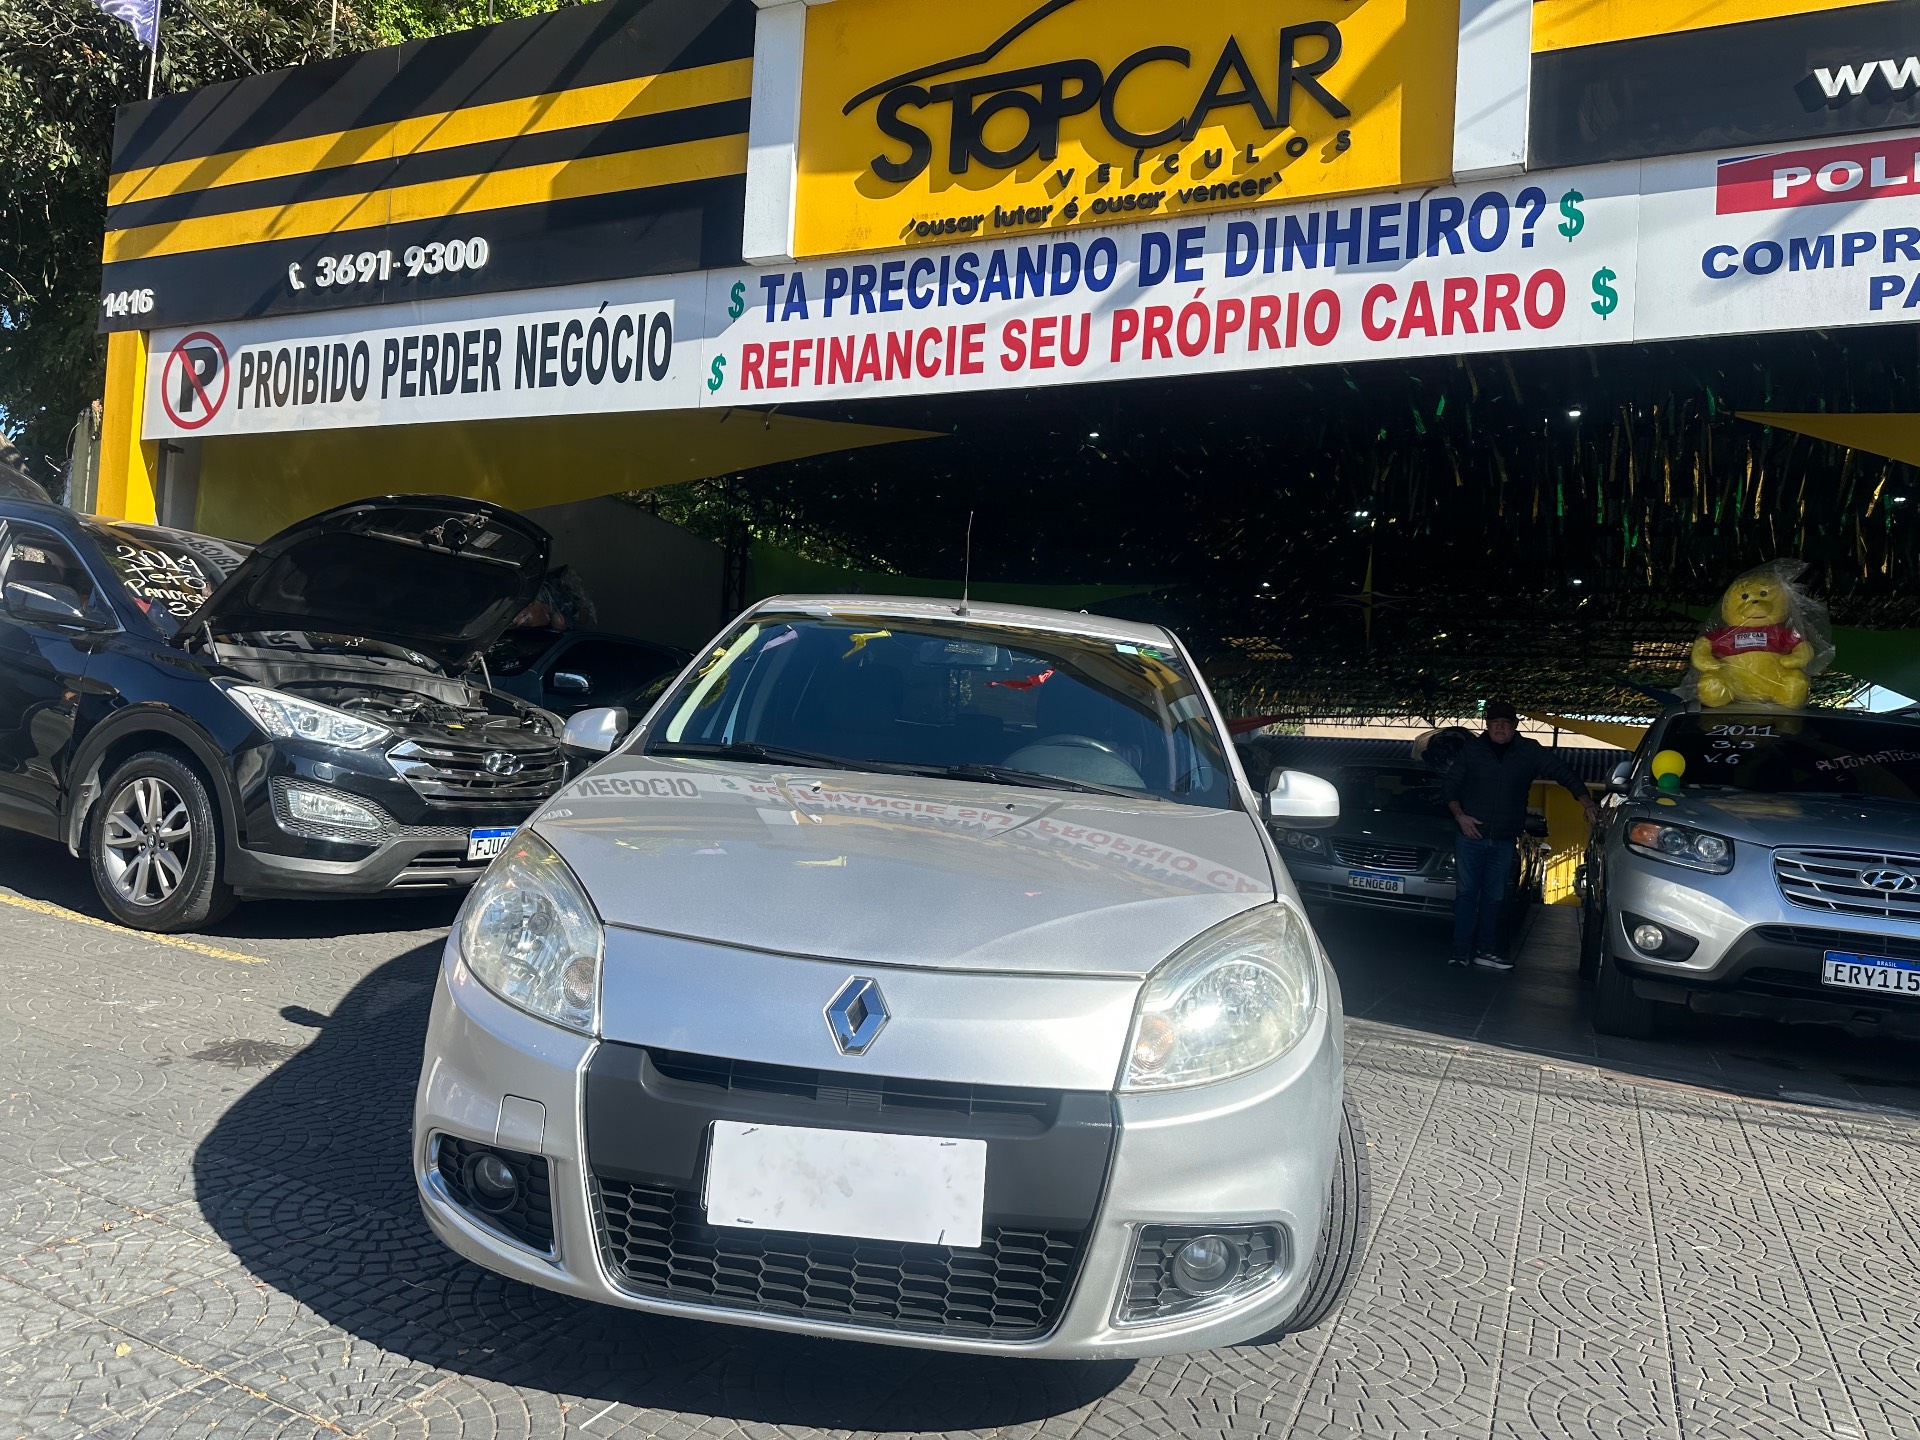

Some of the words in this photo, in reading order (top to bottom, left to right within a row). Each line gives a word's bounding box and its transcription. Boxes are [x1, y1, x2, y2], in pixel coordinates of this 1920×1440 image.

[1056, 130, 1351, 188] VEÍCULOS
[994, 203, 1053, 228] lutar
[1063, 196, 1079, 219] é
[1091, 189, 1166, 214] ousar
[315, 236, 490, 287] 3691-9300
[760, 272, 809, 323] TA
[823, 237, 1118, 318] PRECISANDO
[1138, 226, 1205, 288] DE
[1224, 186, 1547, 278] DINHEIRO?
[103, 288, 155, 318] 1416
[740, 323, 986, 390] REFINANCIE
[1000, 312, 1091, 372] SEU
[1110, 288, 1341, 363] PRÓPRIO
[1361, 268, 1566, 342] CARRO
[237, 340, 370, 410] PROIBIDO
[381, 328, 502, 400] PERDER
[514, 301, 673, 390] NEGÓCIO
[1704, 724, 1781, 738] 2011
[1711, 740, 1757, 750] 3.5
